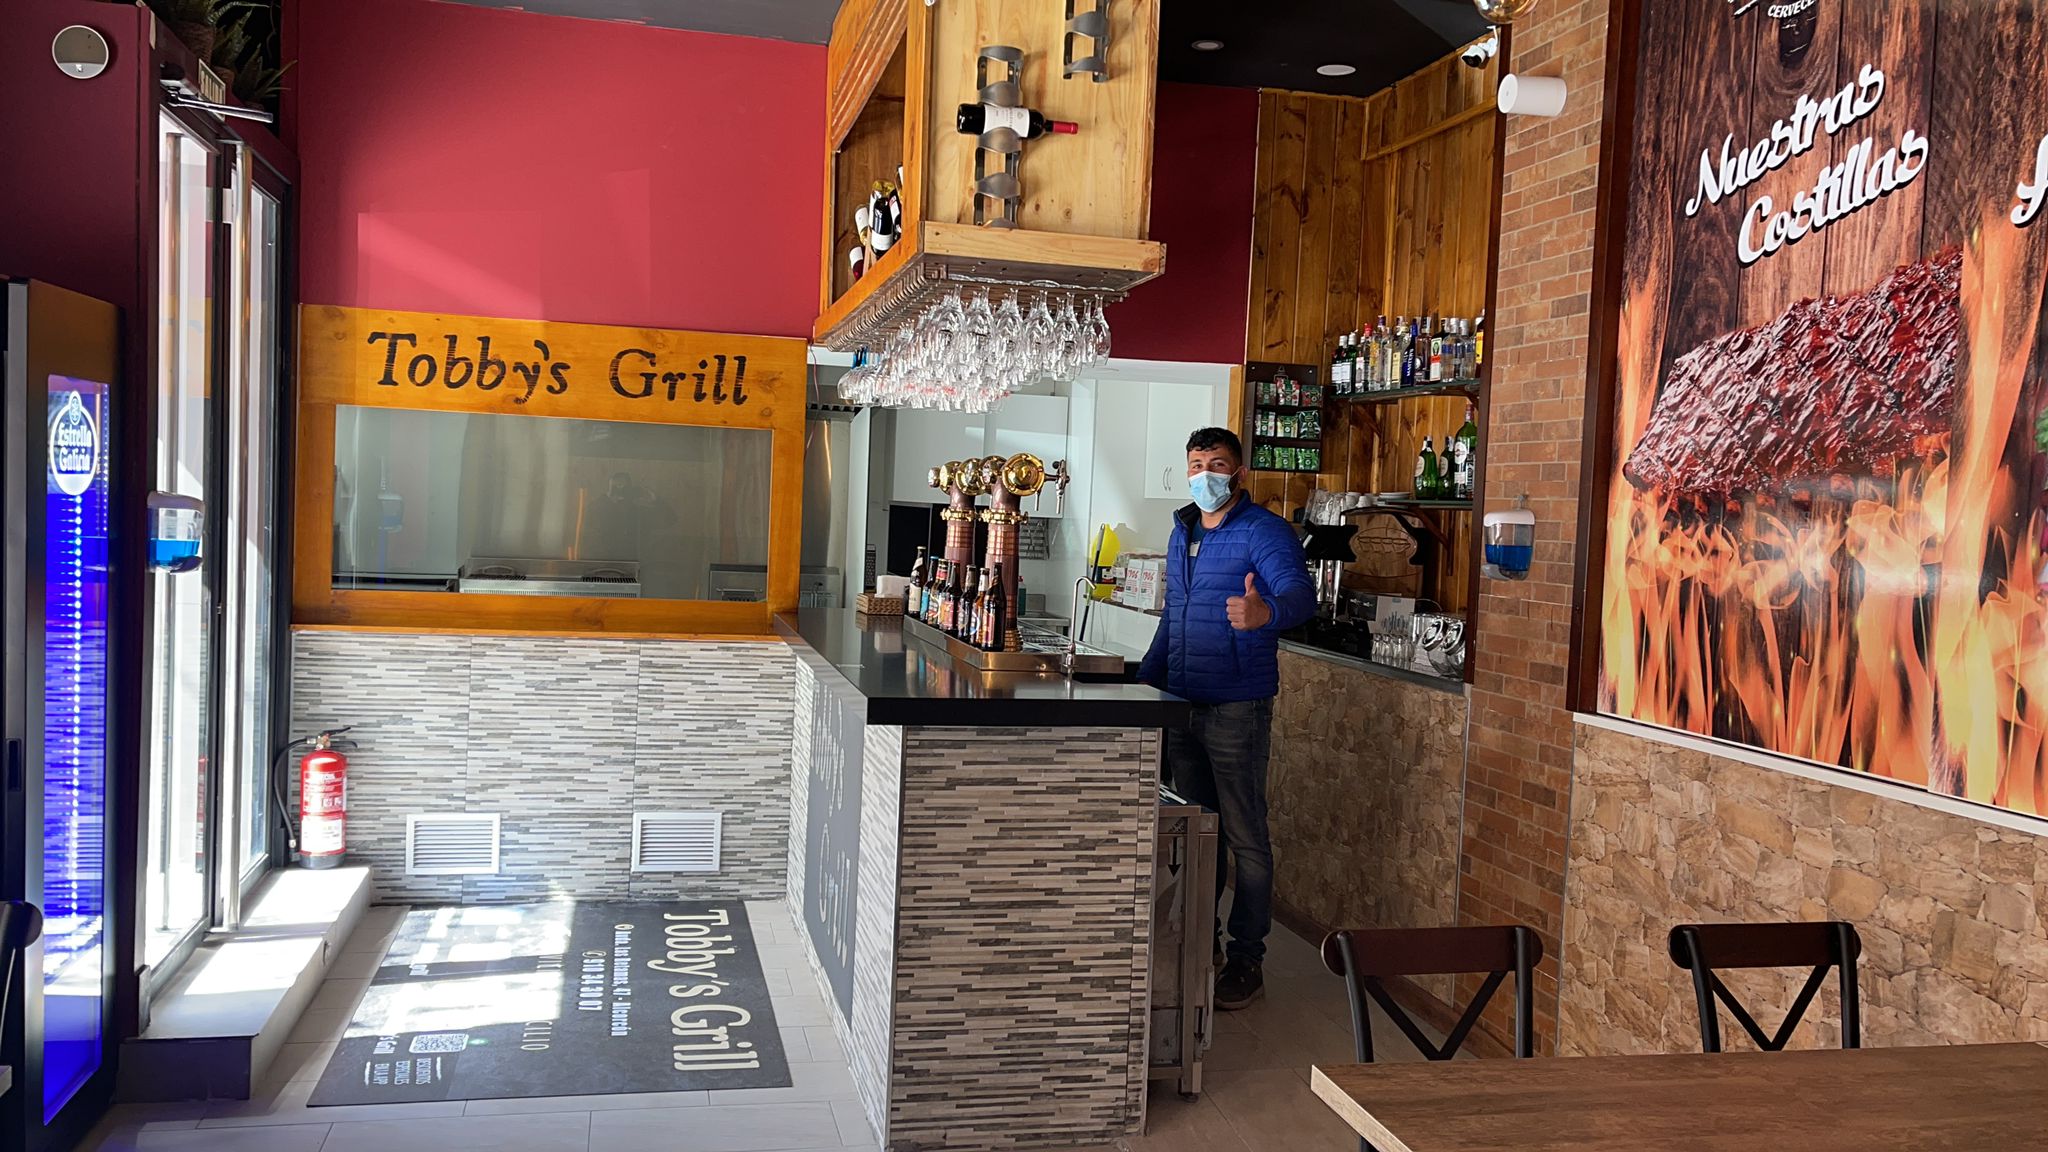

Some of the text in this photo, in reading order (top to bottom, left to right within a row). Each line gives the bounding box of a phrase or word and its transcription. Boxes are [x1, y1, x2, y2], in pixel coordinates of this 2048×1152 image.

[1767, 0, 1816, 18] CERVEC
[1685, 63, 1885, 217] Nuestras
[1737, 129, 1930, 265] Costillas
[367, 331, 749, 406] Tobby's Grill
[57, 422, 92, 447] Estrella
[59, 446, 91, 472] Galicia
[810, 679, 845, 818] Tobby's
[819, 823, 850, 969] Grill
[577, 959, 605, 1011] 910 34 30 07
[647, 909, 760, 1071] Tobby's Grill
[520, 1020, 553, 1050] CILIO
[611, 1002, 632, 1036] Alcorcón
